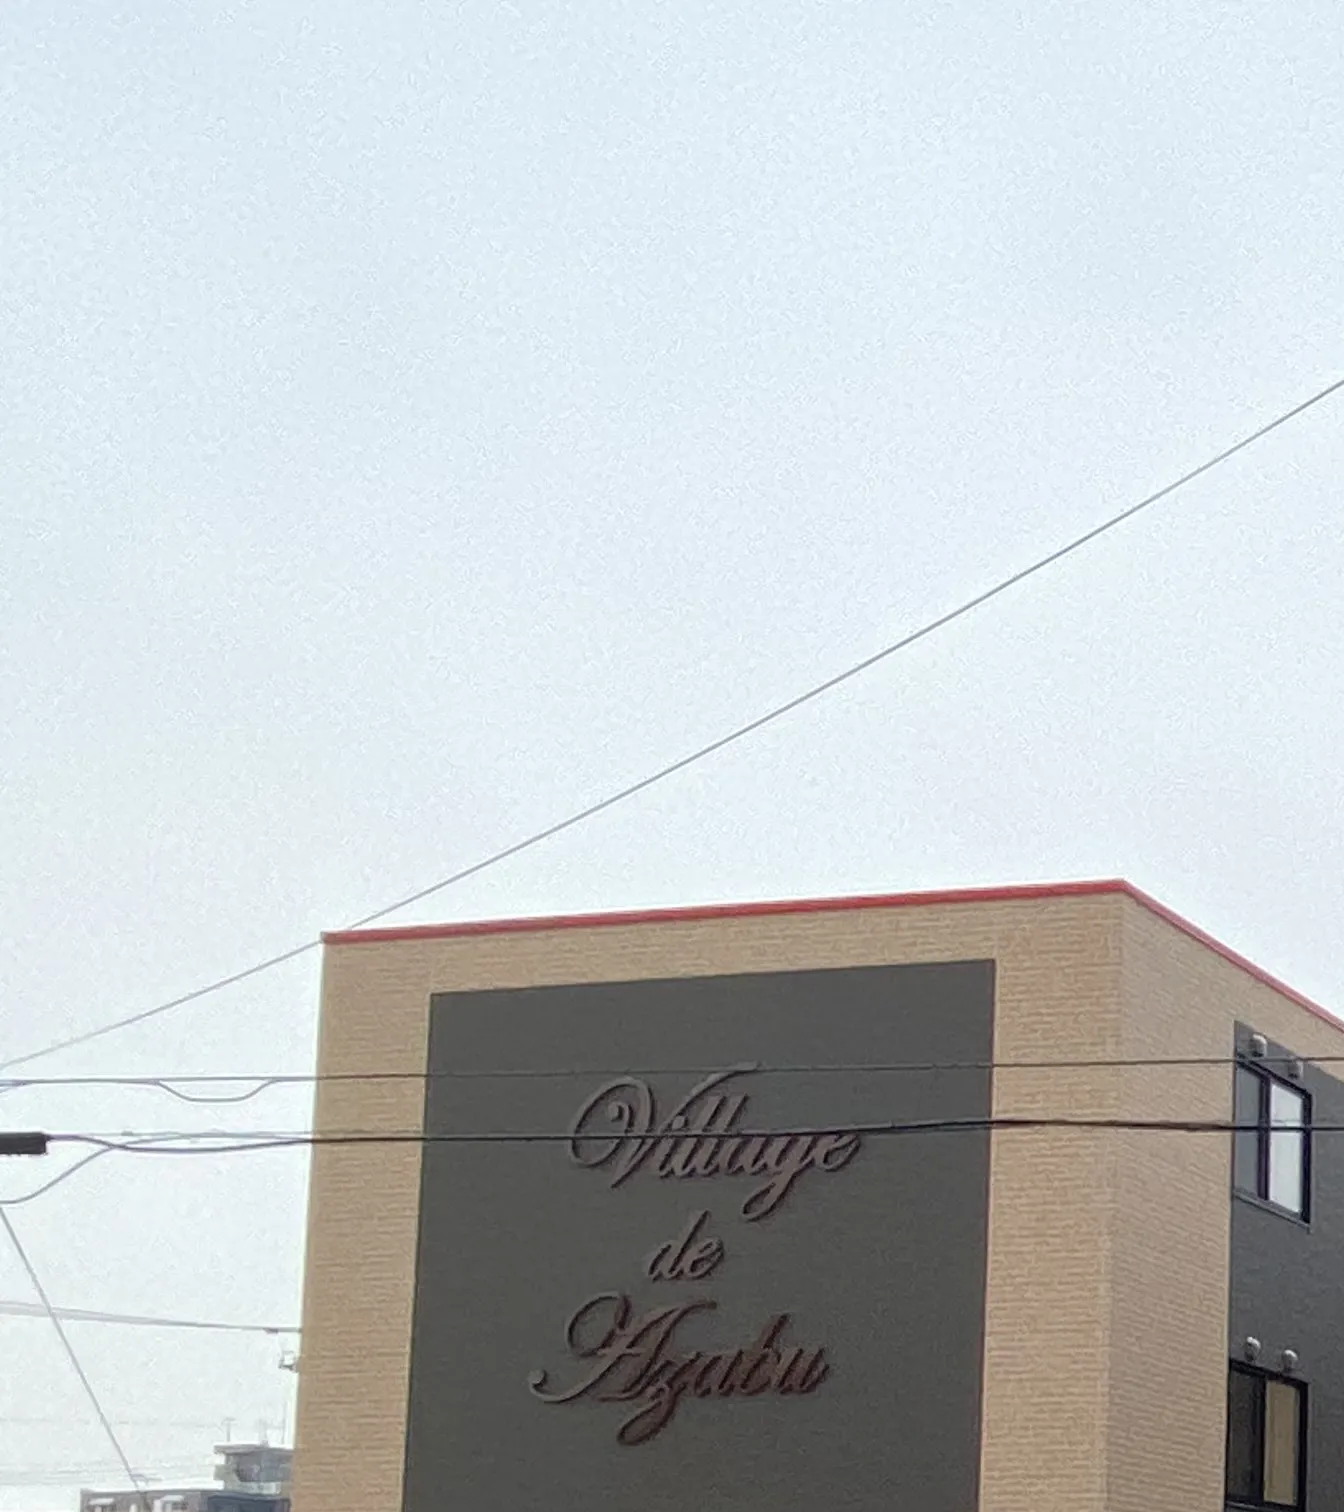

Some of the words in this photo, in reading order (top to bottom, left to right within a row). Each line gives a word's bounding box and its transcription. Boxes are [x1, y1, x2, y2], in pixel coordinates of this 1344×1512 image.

[570, 1060, 862, 1222] Village
[645, 1209, 725, 1283] de
[528, 1291, 830, 1447] Azabu
